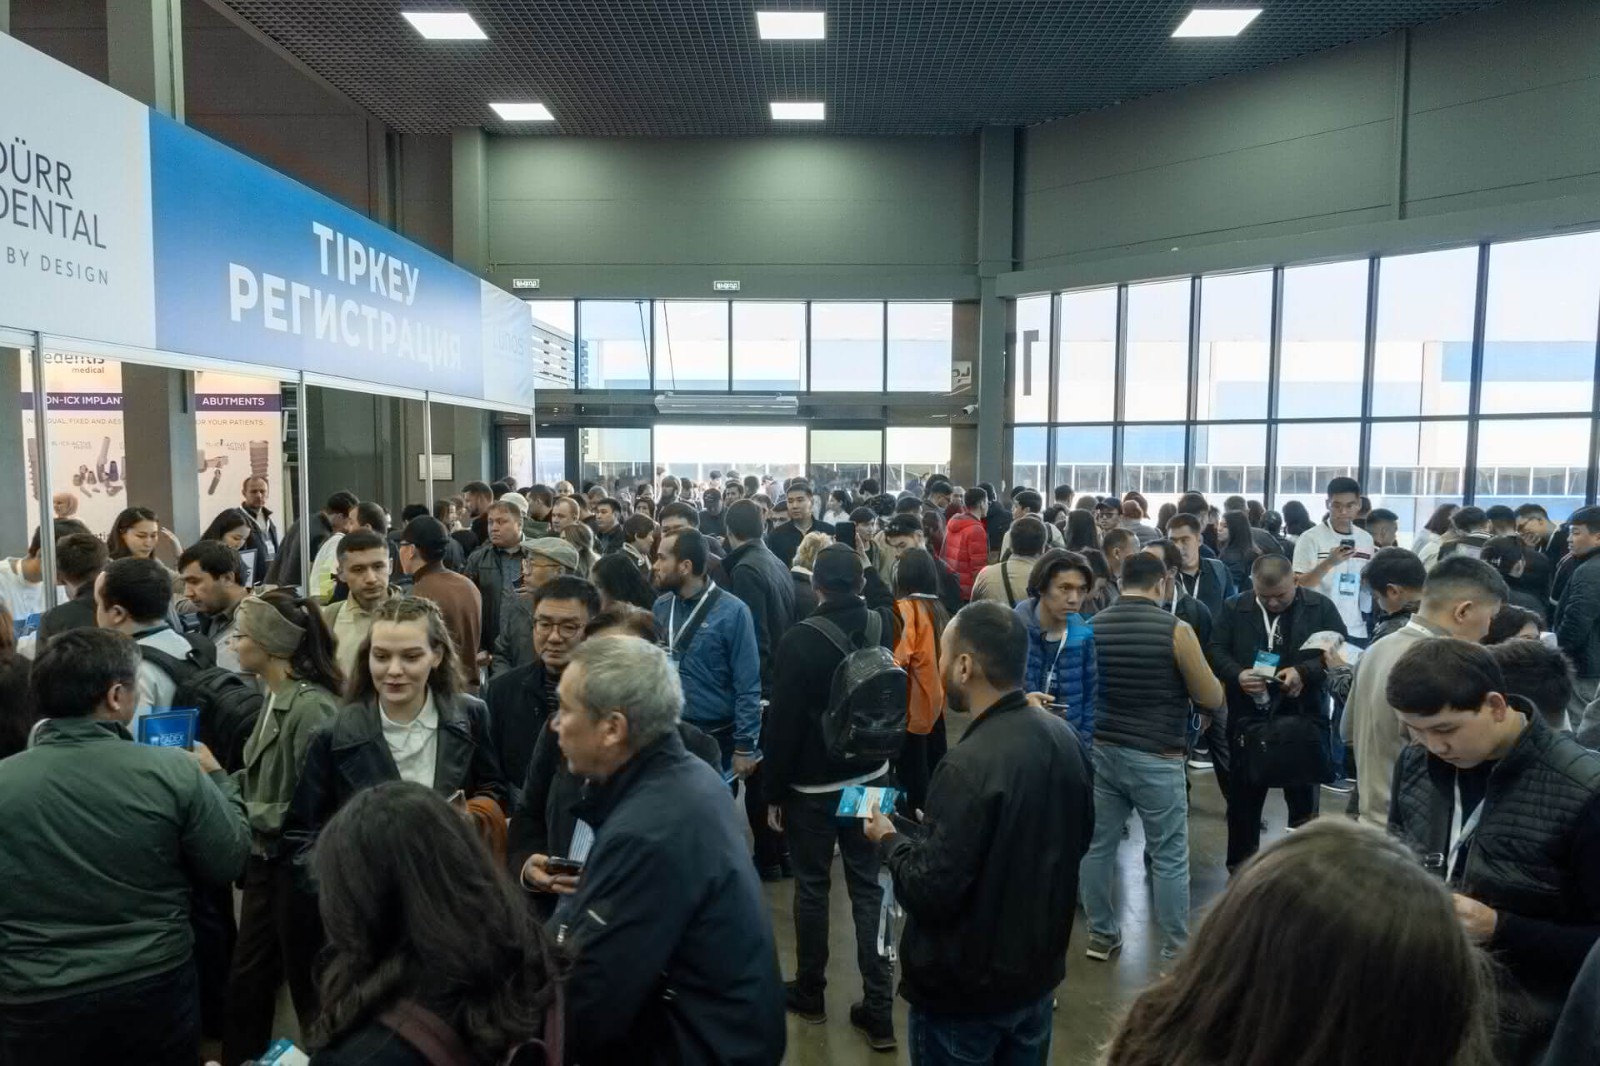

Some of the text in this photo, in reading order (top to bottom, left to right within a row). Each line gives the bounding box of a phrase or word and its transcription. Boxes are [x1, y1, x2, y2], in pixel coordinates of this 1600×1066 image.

[7, 246, 108, 286] BY DESIGN
[312, 221, 420, 306] ТІРКЕУ
[229, 262, 461, 373] РЕГИСТРАЦИЯ
[72, 366, 105, 374] medical
[82, 396, 123, 405] IMPLAN
[202, 397, 265, 406] ABUTMENTS
